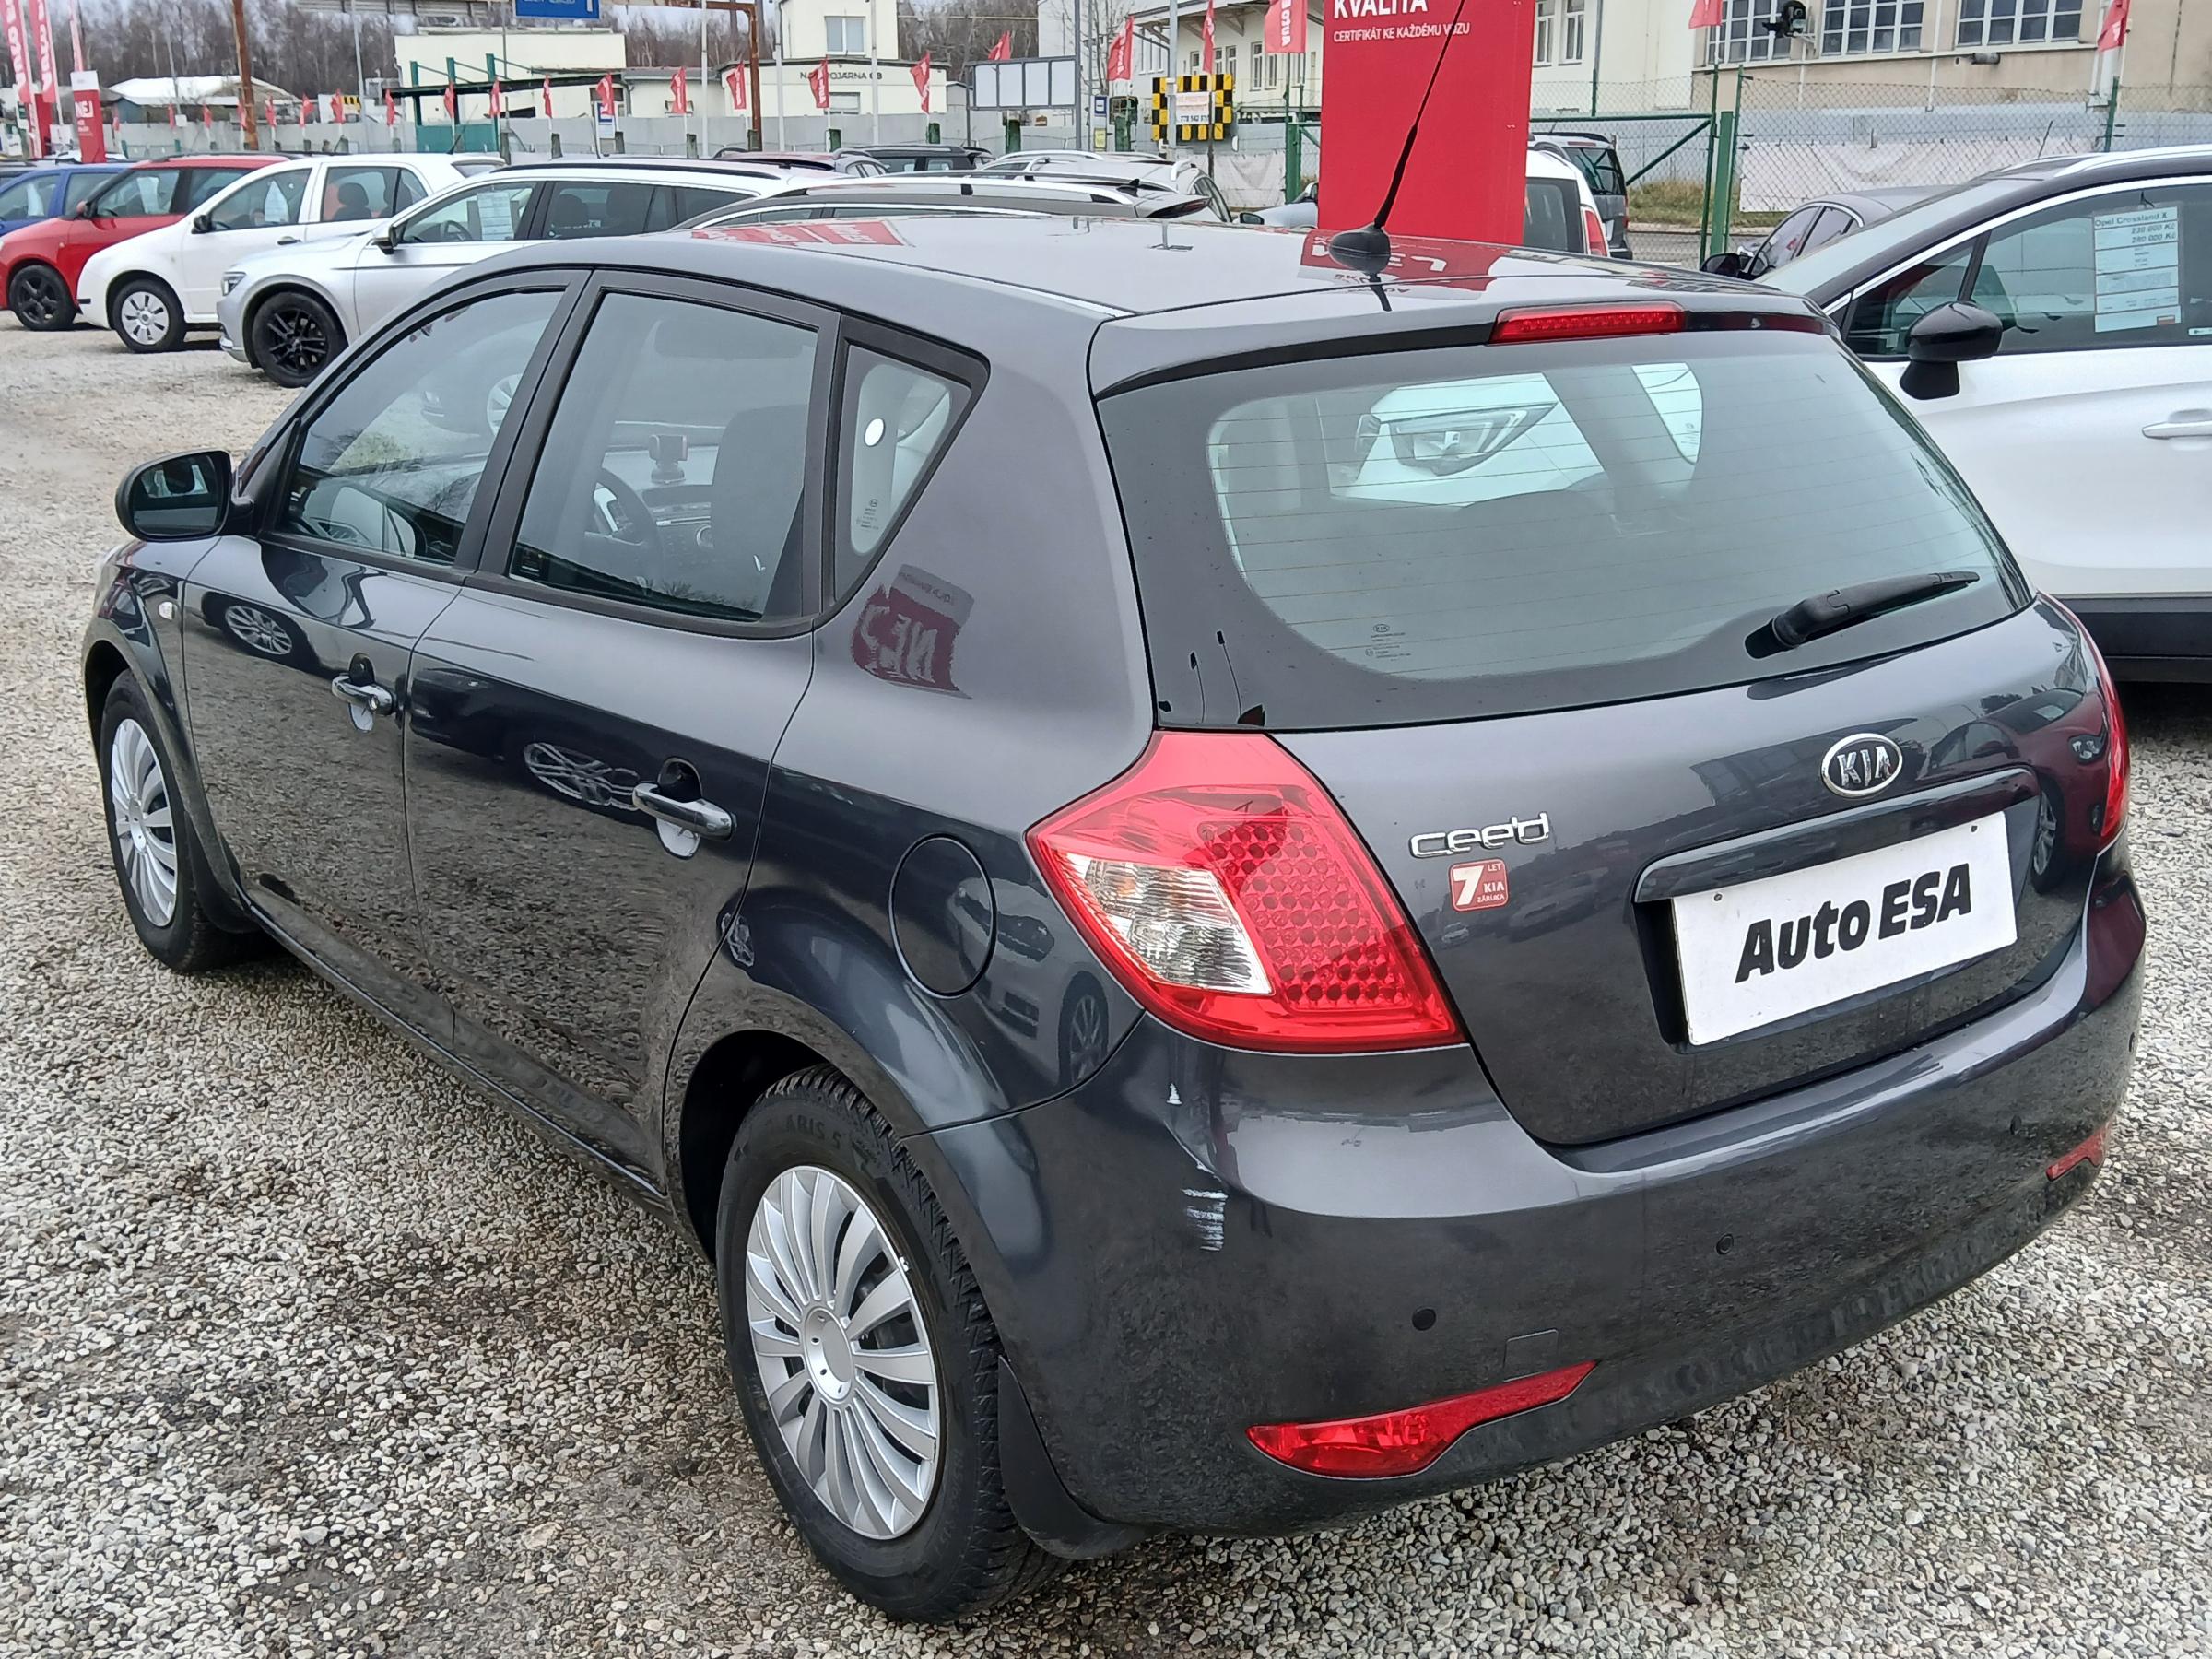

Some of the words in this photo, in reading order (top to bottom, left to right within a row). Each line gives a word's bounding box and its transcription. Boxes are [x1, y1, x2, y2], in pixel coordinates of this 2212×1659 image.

[1334, 27, 1382, 42] CERTIFIKÁT
[1382, 27, 1395, 40] KE
[1396, 23, 1441, 39] KAŽDÉMU
[2116, 213, 2159, 224] Crossland
[1836, 746, 1893, 786] KIA
[1453, 865, 1485, 907] 7
[1488, 863, 1502, 872] LET
[1483, 881, 1505, 894] KIA
[1735, 900, 1871, 984] Auto
[1878, 862, 1971, 941] ESA
